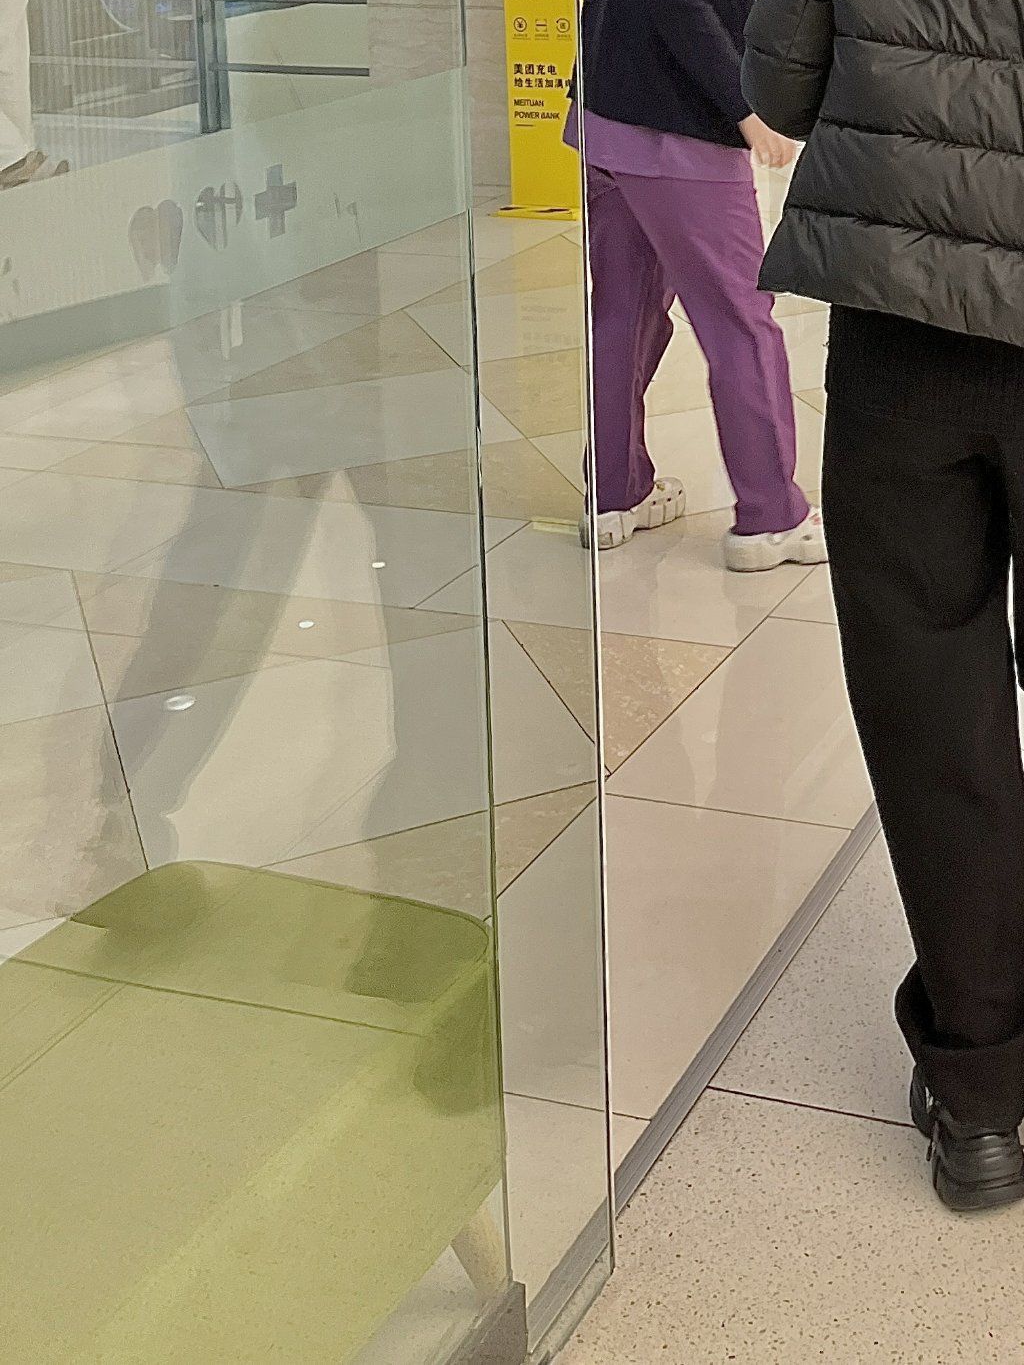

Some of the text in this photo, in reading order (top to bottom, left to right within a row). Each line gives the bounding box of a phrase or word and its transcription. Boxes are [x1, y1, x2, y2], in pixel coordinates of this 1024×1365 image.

[513, 63, 557, 75] 美团充电
[513, 99, 544, 107] MEITUAN
[514, 111, 560, 120] POWER BANK
